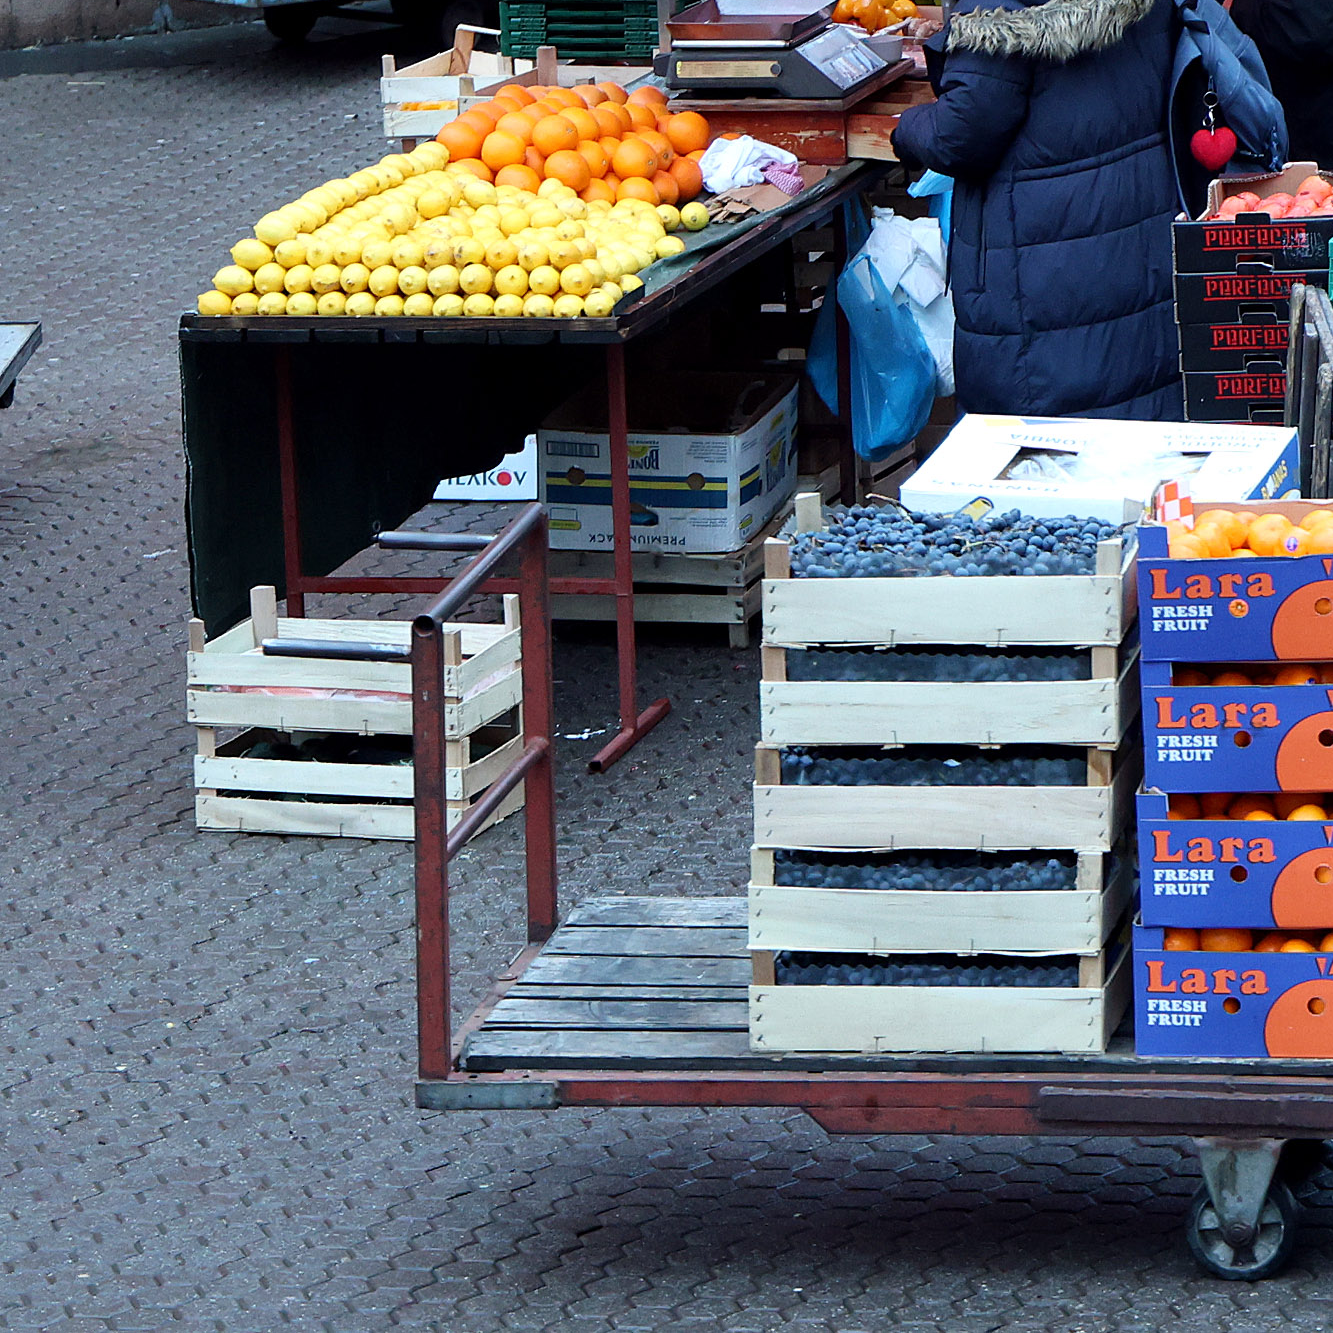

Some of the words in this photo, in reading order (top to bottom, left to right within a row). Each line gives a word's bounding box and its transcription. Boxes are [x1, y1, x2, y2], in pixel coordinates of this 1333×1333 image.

[588, 533, 614, 543] ACK
[1151, 569, 1275, 599] Lara
[1152, 606, 1213, 617] FRESH
[1152, 619, 1209, 632] FRUIT
[1155, 697, 1280, 728] Lara
[1157, 735, 1218, 747] FRESH
[1157, 749, 1214, 762] FRUIT
[1153, 830, 1276, 863] Lara
[1154, 869, 1214, 882] FRESH
[1154, 883, 1210, 896] FRUIT
[1147, 962, 1269, 995] Lara
[1147, 999, 1207, 1012] FRESH
[1147, 1014, 1203, 1026] FRUIT
